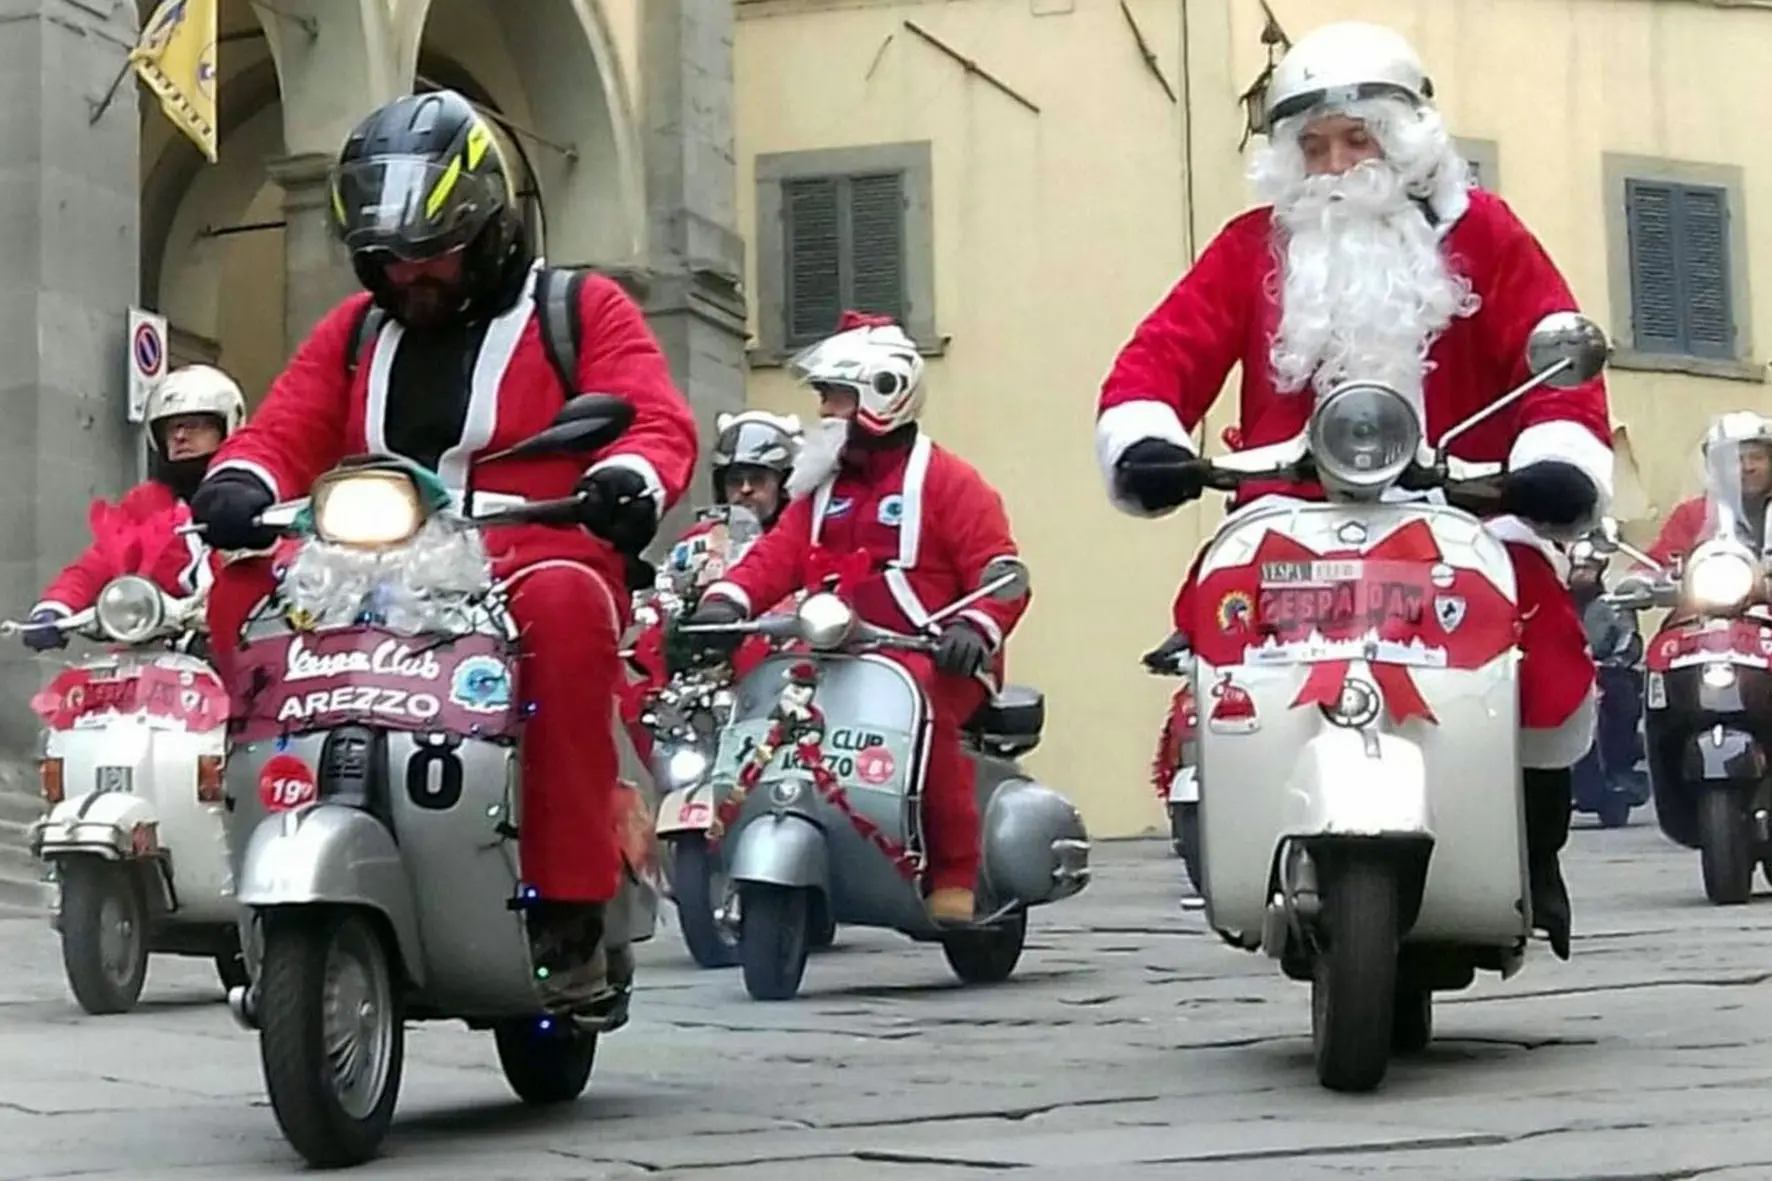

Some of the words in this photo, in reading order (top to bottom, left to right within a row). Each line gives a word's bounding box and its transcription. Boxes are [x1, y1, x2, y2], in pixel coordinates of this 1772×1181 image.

[283, 636, 370, 681] Vespa
[371, 639, 440, 680] Club
[278, 686, 440, 722] AREZZO
